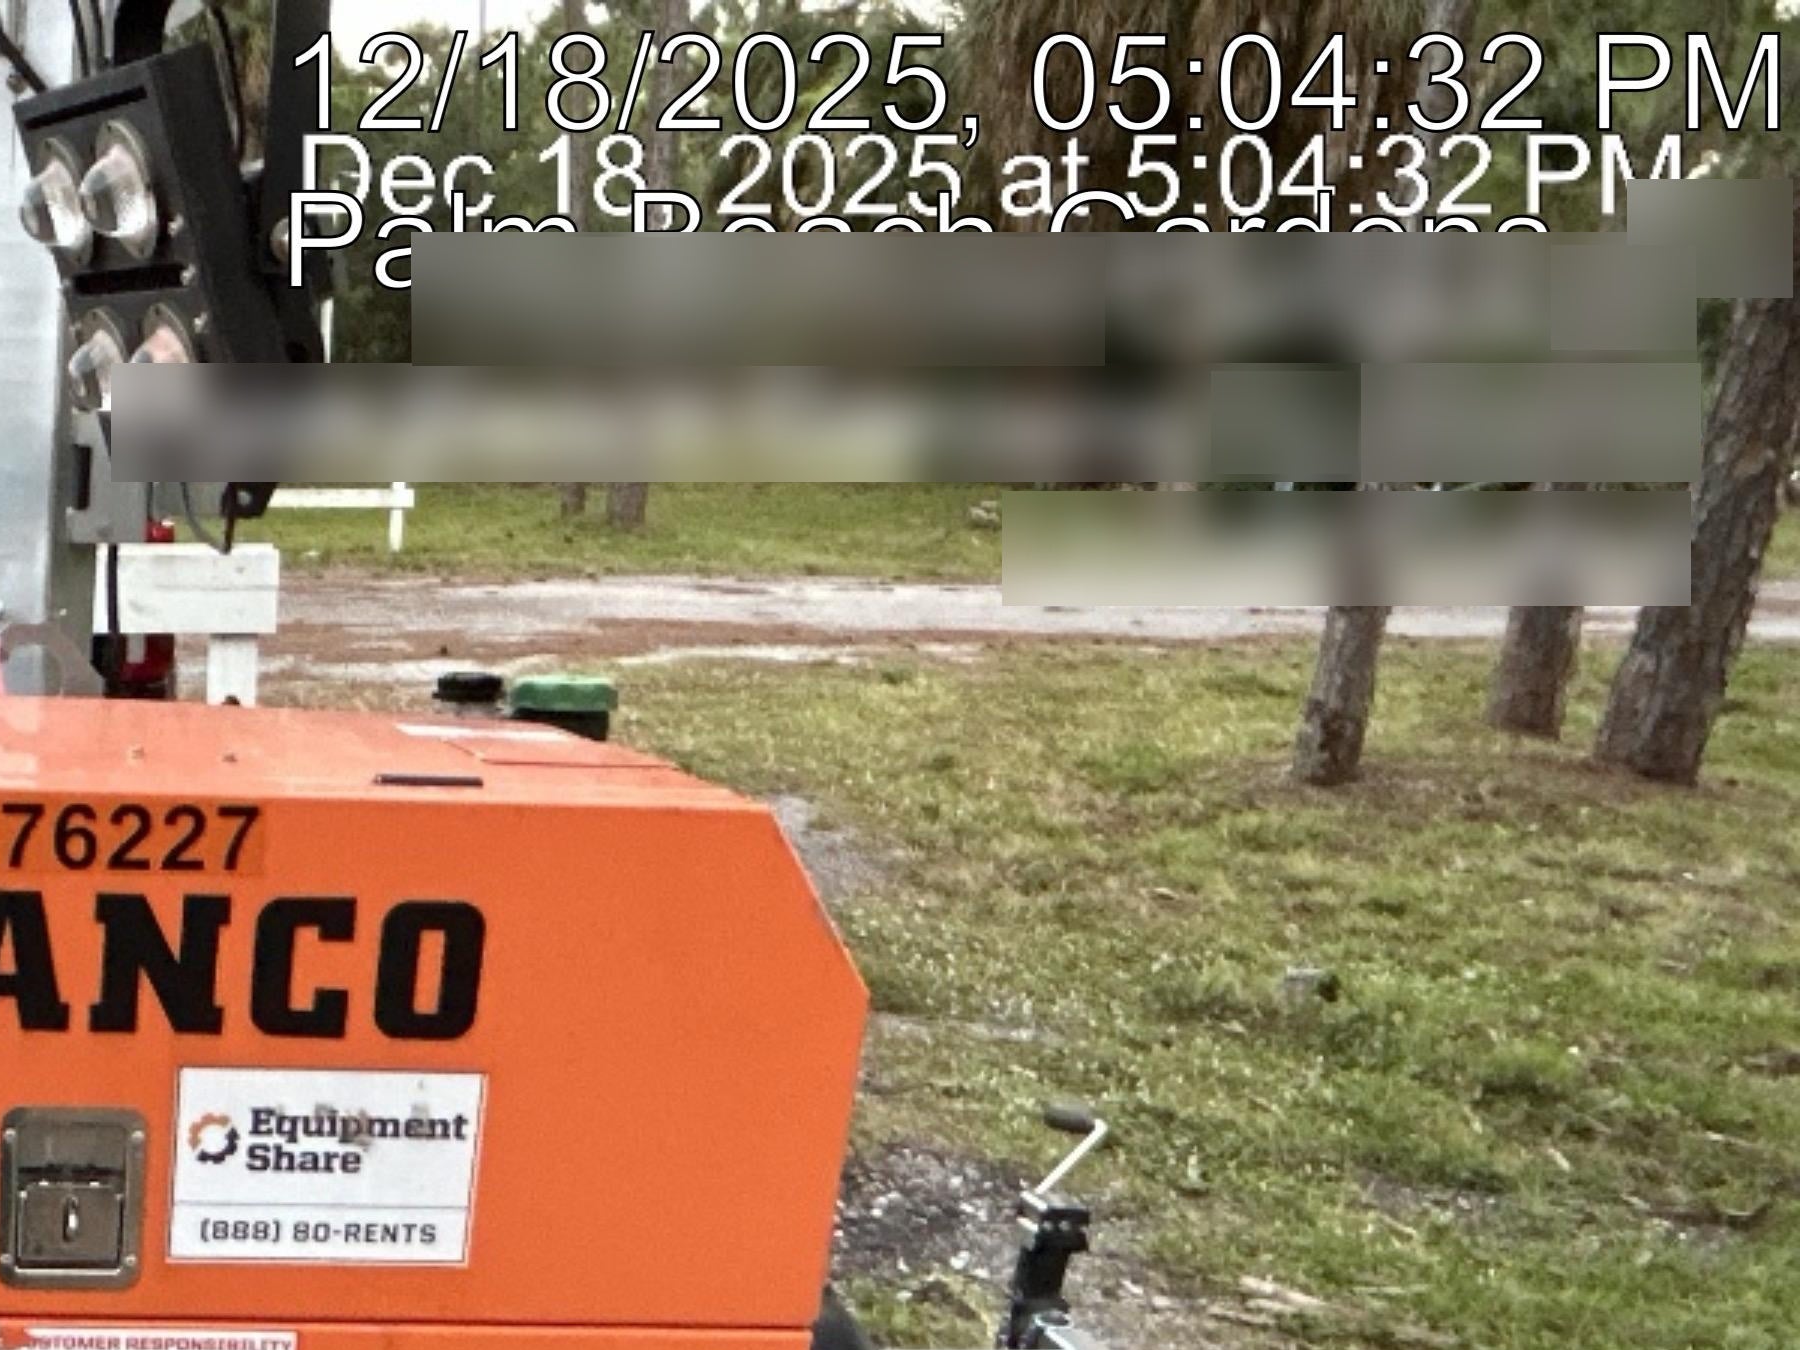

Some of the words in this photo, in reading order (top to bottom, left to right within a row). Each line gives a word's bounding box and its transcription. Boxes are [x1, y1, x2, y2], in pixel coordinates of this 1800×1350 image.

[249, 1106, 469, 1145] Equipment
[245, 1142, 362, 1174] Share
[200, 1217, 282, 1244] (888)
[292, 1220, 437, 1245] 80-RENTS
